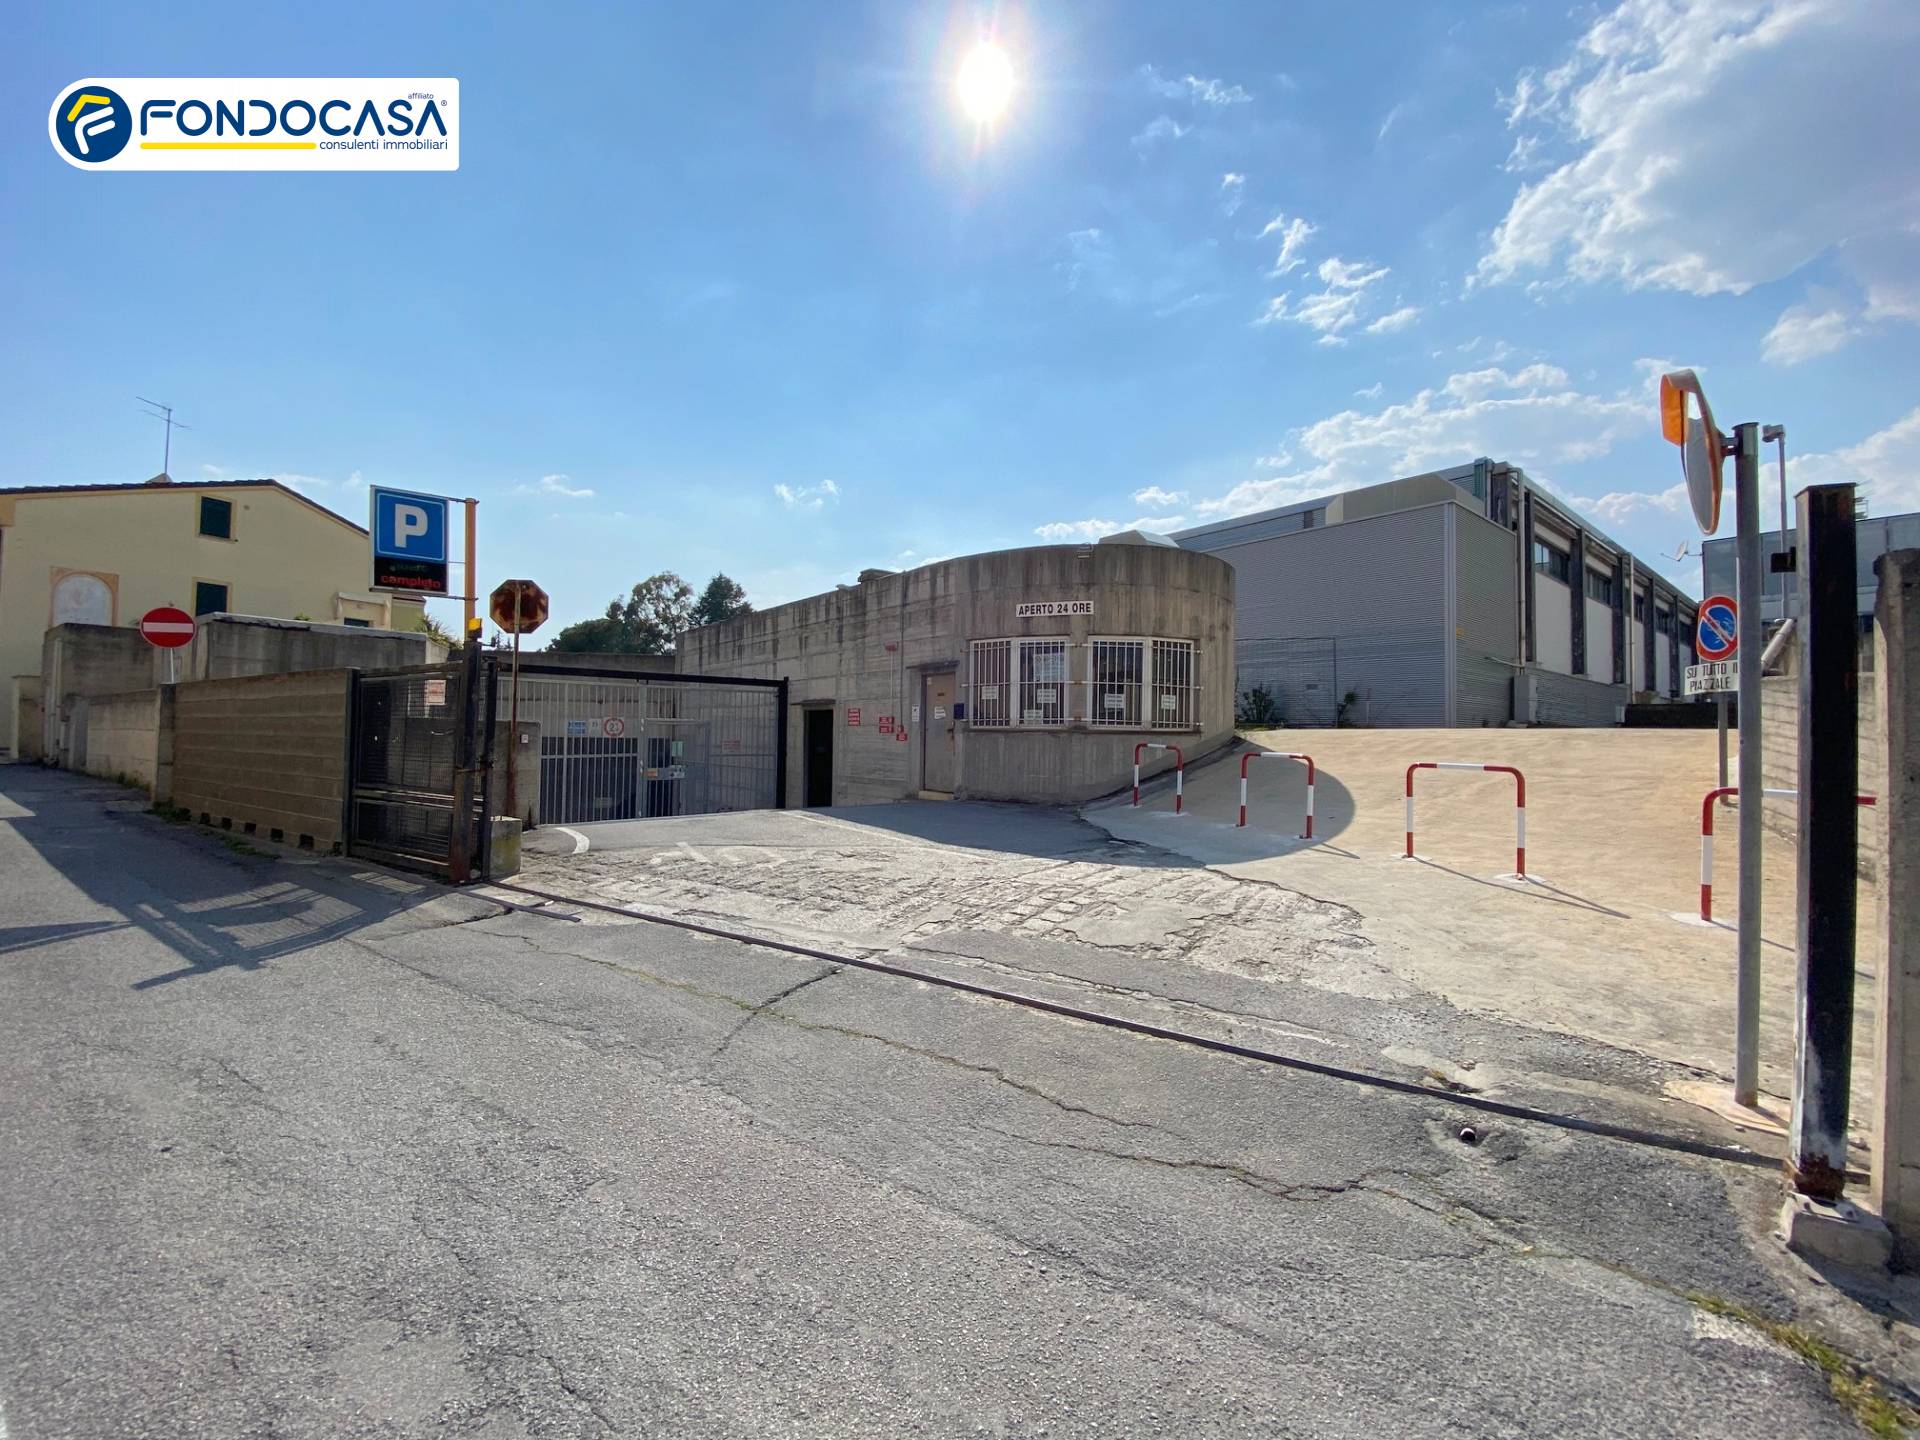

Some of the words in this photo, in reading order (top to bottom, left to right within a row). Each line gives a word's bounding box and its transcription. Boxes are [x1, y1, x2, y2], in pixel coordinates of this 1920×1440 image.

[395, 503, 428, 548] P
[380, 574, 442, 589] completo
[1018, 604, 1054, 615] APERTO
[1057, 603, 1068, 614] 24
[1072, 602, 1091, 613] ORE
[1686, 667, 1698, 679] SU
[1703, 663, 1727, 676] TUTTO
[1689, 676, 1730, 692] PIAZZALE
